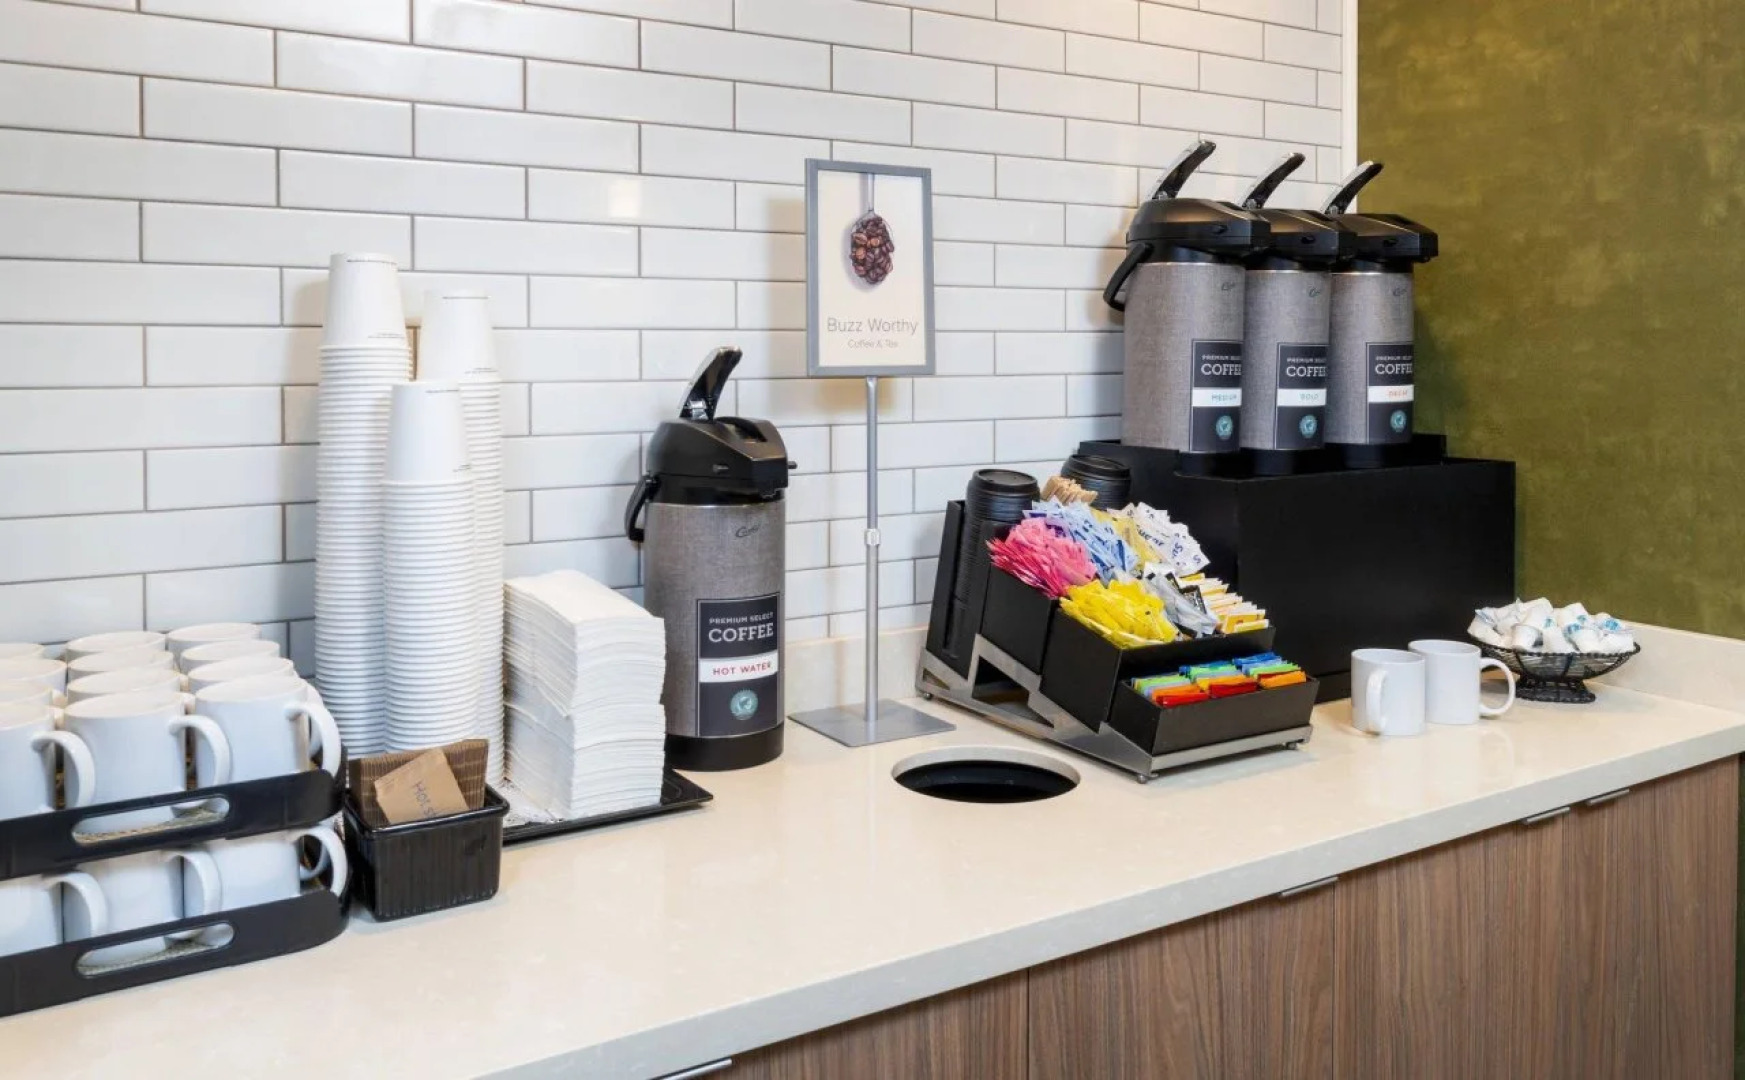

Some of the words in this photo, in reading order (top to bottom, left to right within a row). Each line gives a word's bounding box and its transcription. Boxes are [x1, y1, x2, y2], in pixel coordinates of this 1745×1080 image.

[827, 317, 863, 332] Buzz
[866, 317, 919, 336] Worthy
[847, 339, 875, 349] Coffee
[1136, 524, 1165, 547] ugar
[708, 616, 748, 625] PREMIUM
[749, 611, 774, 622] SELECT
[708, 622, 774, 643] COFFEE
[712, 666, 736, 676] HOT
[740, 660, 772, 674] WATER
